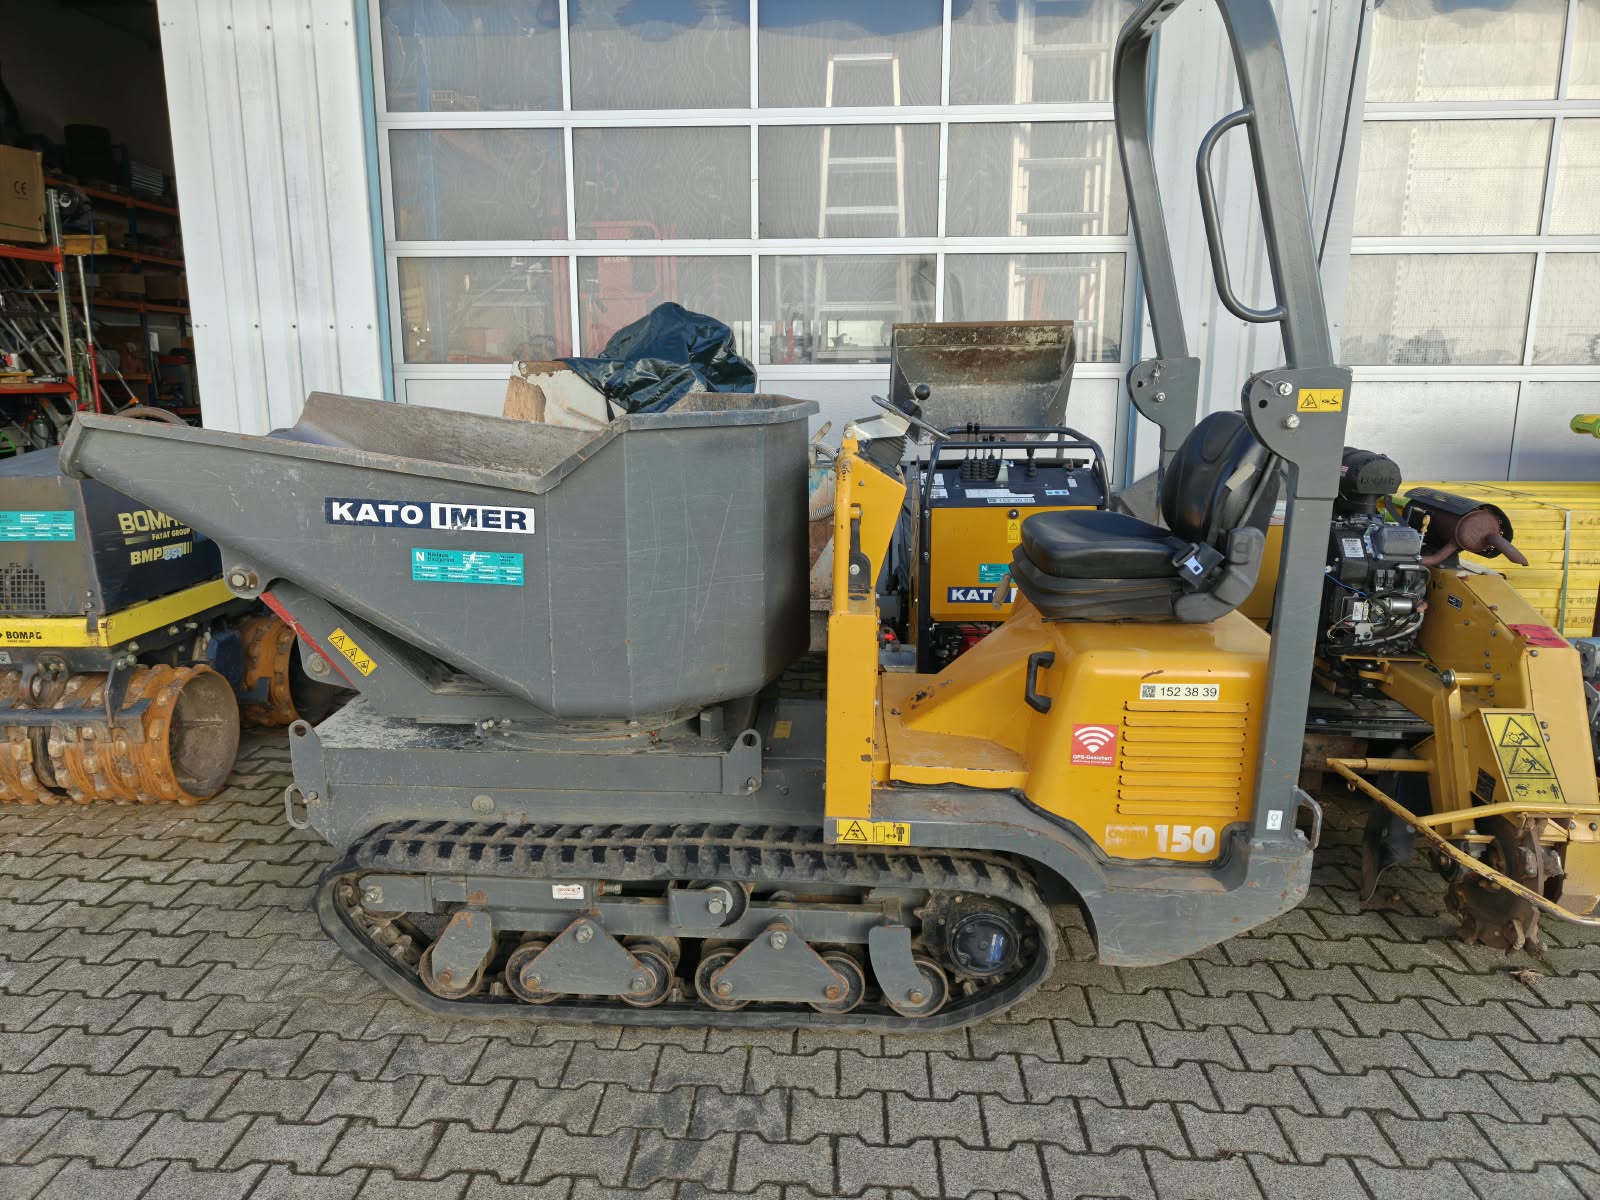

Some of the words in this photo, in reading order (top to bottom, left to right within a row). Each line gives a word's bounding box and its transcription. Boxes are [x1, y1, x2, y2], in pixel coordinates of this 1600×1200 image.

[332, 501, 424, 524] KATO
[438, 507, 527, 530] IMER
[118, 510, 186, 534] BOMA
[152, 531, 170, 540] FAYAT
[171, 528, 191, 537] GROUP
[416, 552, 424, 561] N
[952, 589, 998, 601] KAT
[6, 631, 42, 640] BOMAG
[1161, 687, 1180, 697] 152
[1184, 687, 1199, 697] 38
[1202, 687, 1217, 697] 39
[1154, 824, 1216, 854] 150
